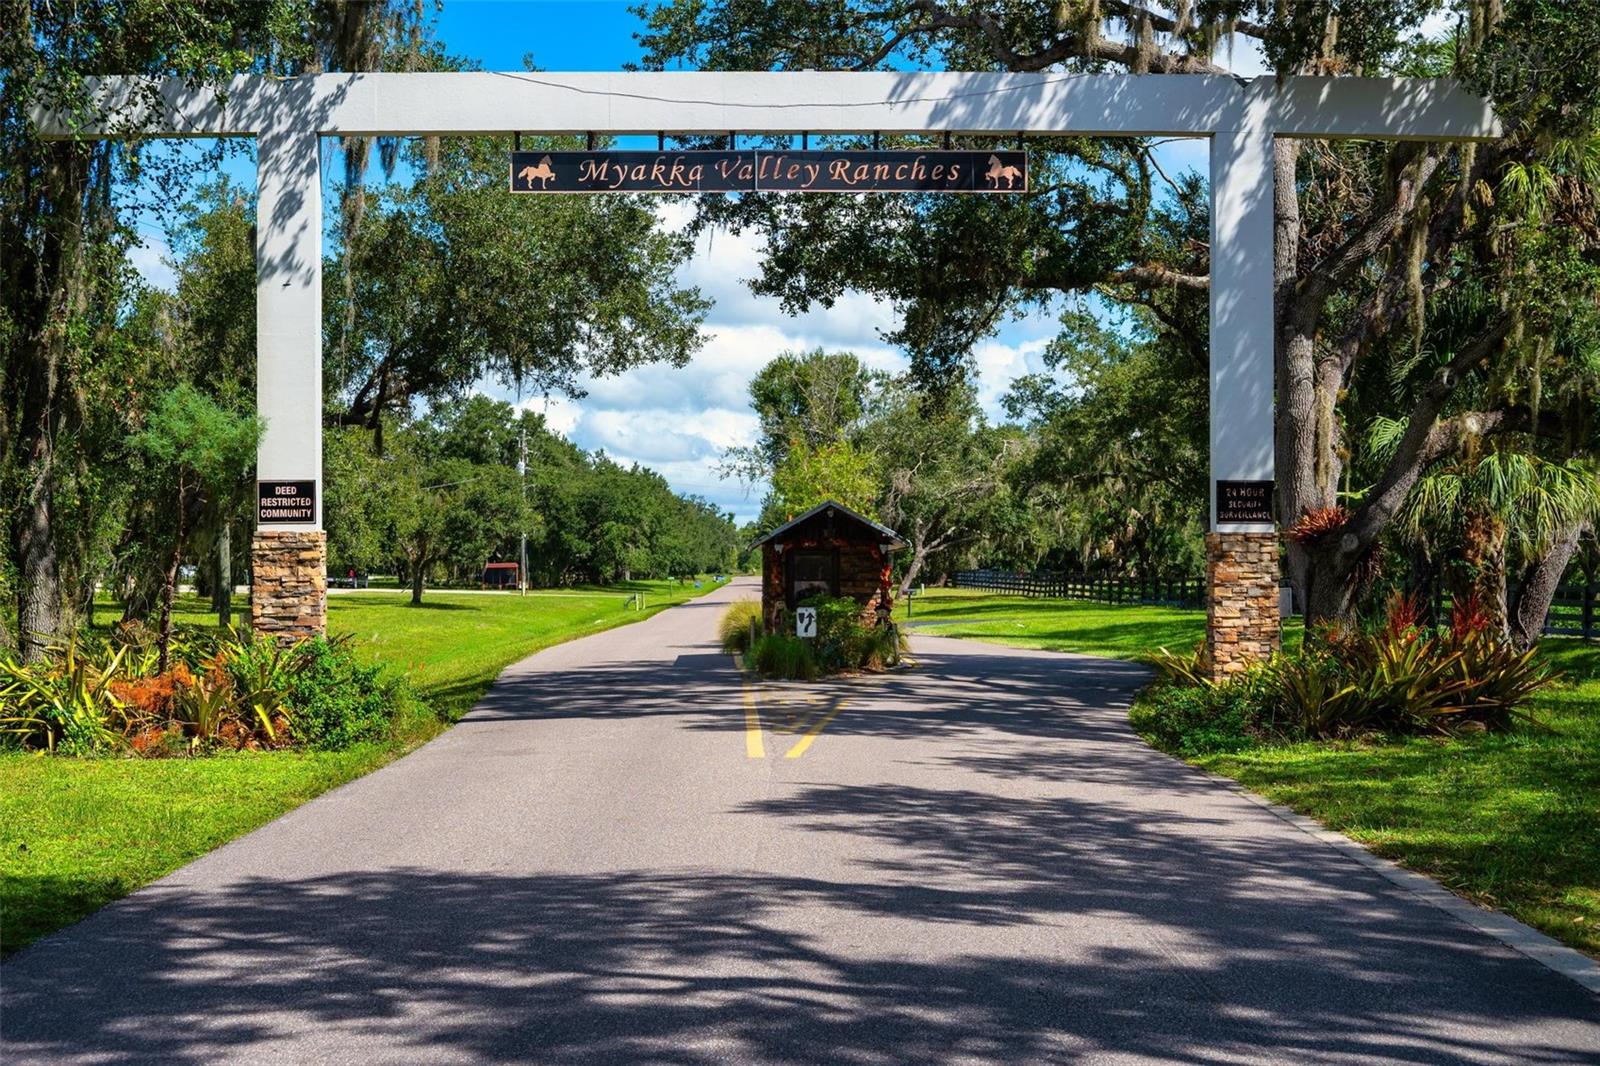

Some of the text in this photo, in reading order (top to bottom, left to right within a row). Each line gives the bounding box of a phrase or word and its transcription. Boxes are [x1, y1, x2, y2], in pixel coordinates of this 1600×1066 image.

[578, 155, 961, 189] Myakka Valley Ranches
[275, 486, 297, 495] DEED
[1226, 487, 1265, 497] 24 HOUR
[261, 497, 311, 507] RESTRICTED
[260, 509, 311, 518] COMMUNITY
